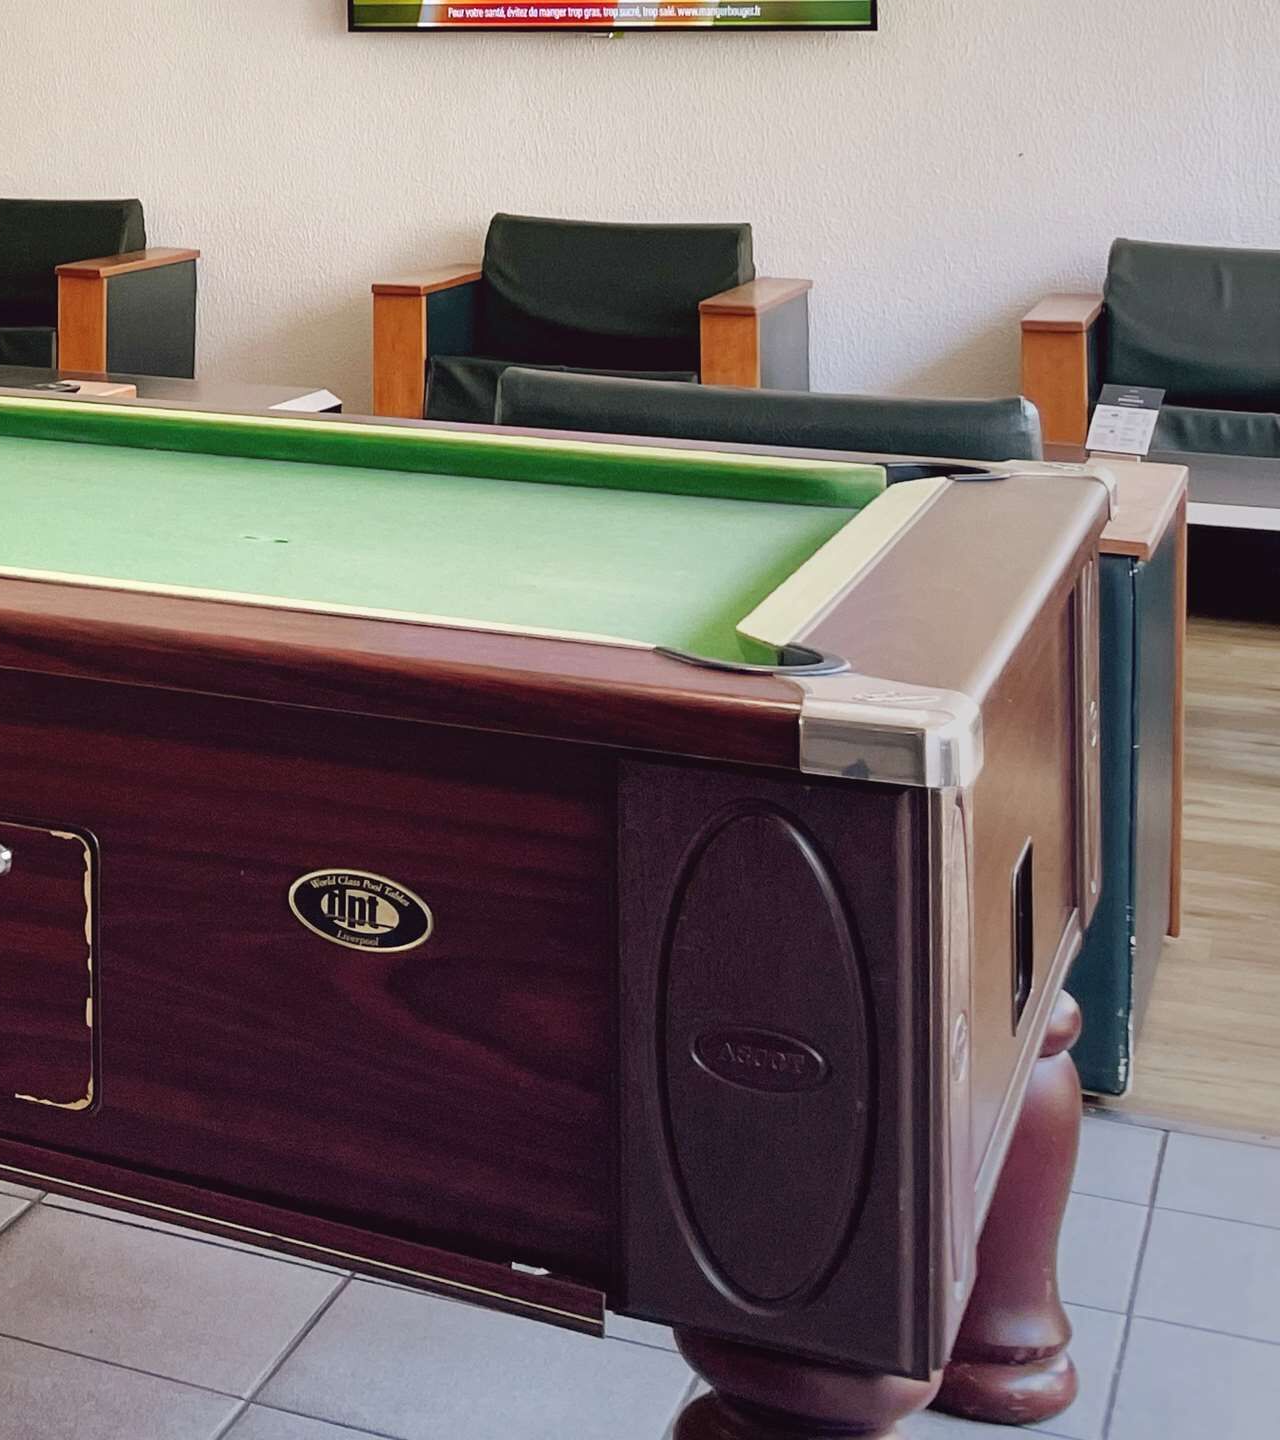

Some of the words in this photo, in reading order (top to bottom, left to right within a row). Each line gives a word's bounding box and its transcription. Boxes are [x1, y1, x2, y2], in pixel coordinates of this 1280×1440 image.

[466, 8, 483, 18] votre
[529, 7, 538, 18] de
[539, 8, 567, 20] manger
[568, 7, 583, 19] trop
[603, 6, 617, 19] trop
[642, 6, 657, 18] trop
[310, 875, 336, 889] World
[337, 875, 360, 887] Class
[362, 879, 383, 892] Pool
[384, 886, 411, 907] Tables
[336, 930, 380, 947] Liverpool
